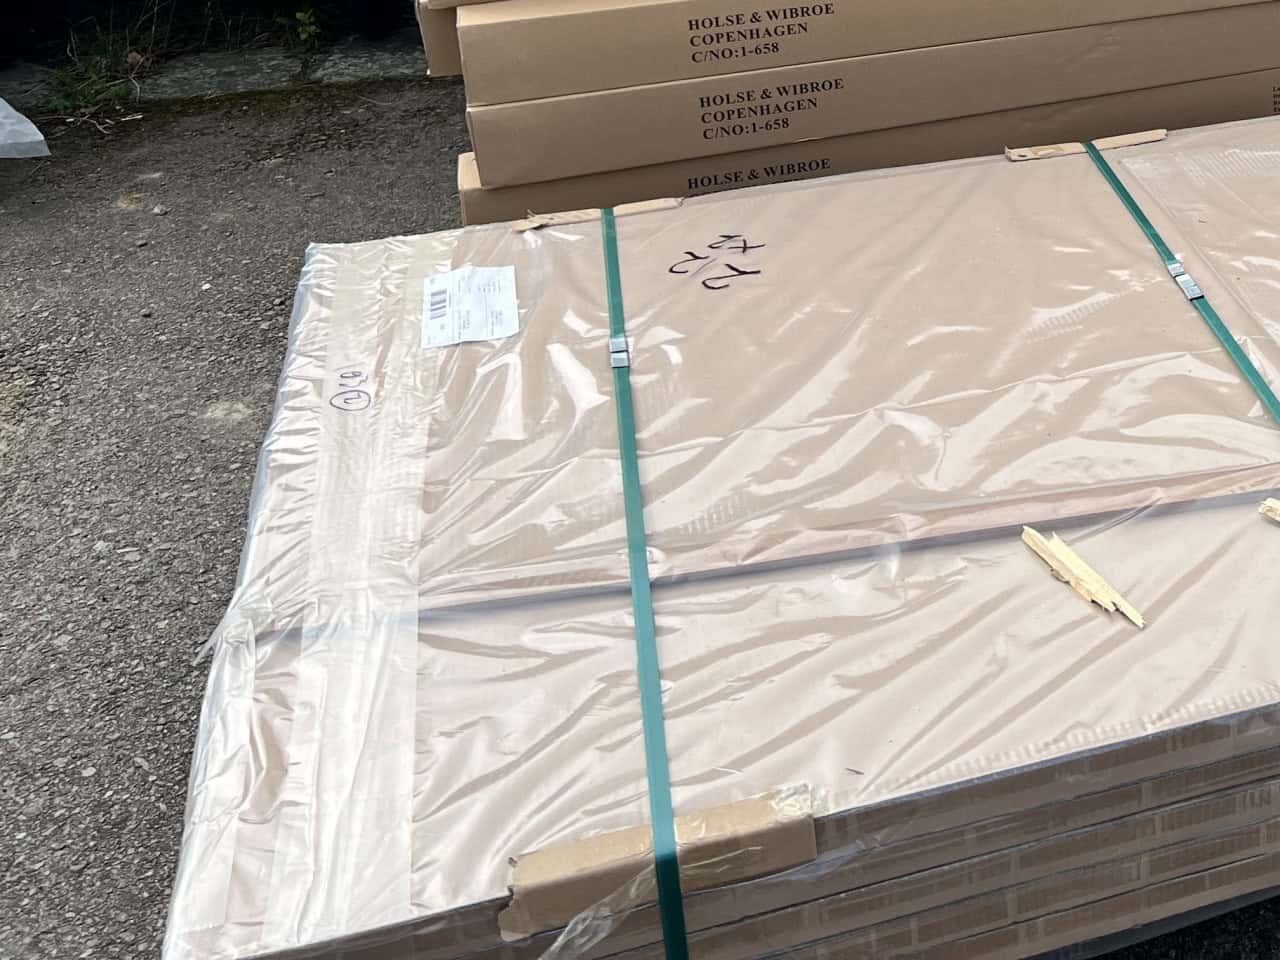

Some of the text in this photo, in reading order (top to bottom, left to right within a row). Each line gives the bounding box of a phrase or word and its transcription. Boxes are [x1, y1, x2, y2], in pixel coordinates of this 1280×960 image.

[688, 3, 835, 31] HOLSE & WIBROE
[689, 22, 808, 47] COPENHAGEN
[691, 42, 779, 63] C/NO:1-658
[699, 78, 844, 108] HOLSE & WIBROE
[701, 97, 817, 124] COPENHAGEN
[702, 117, 789, 140] C/NO:1-658
[688, 158, 831, 189] HOLSE & WIBROE
